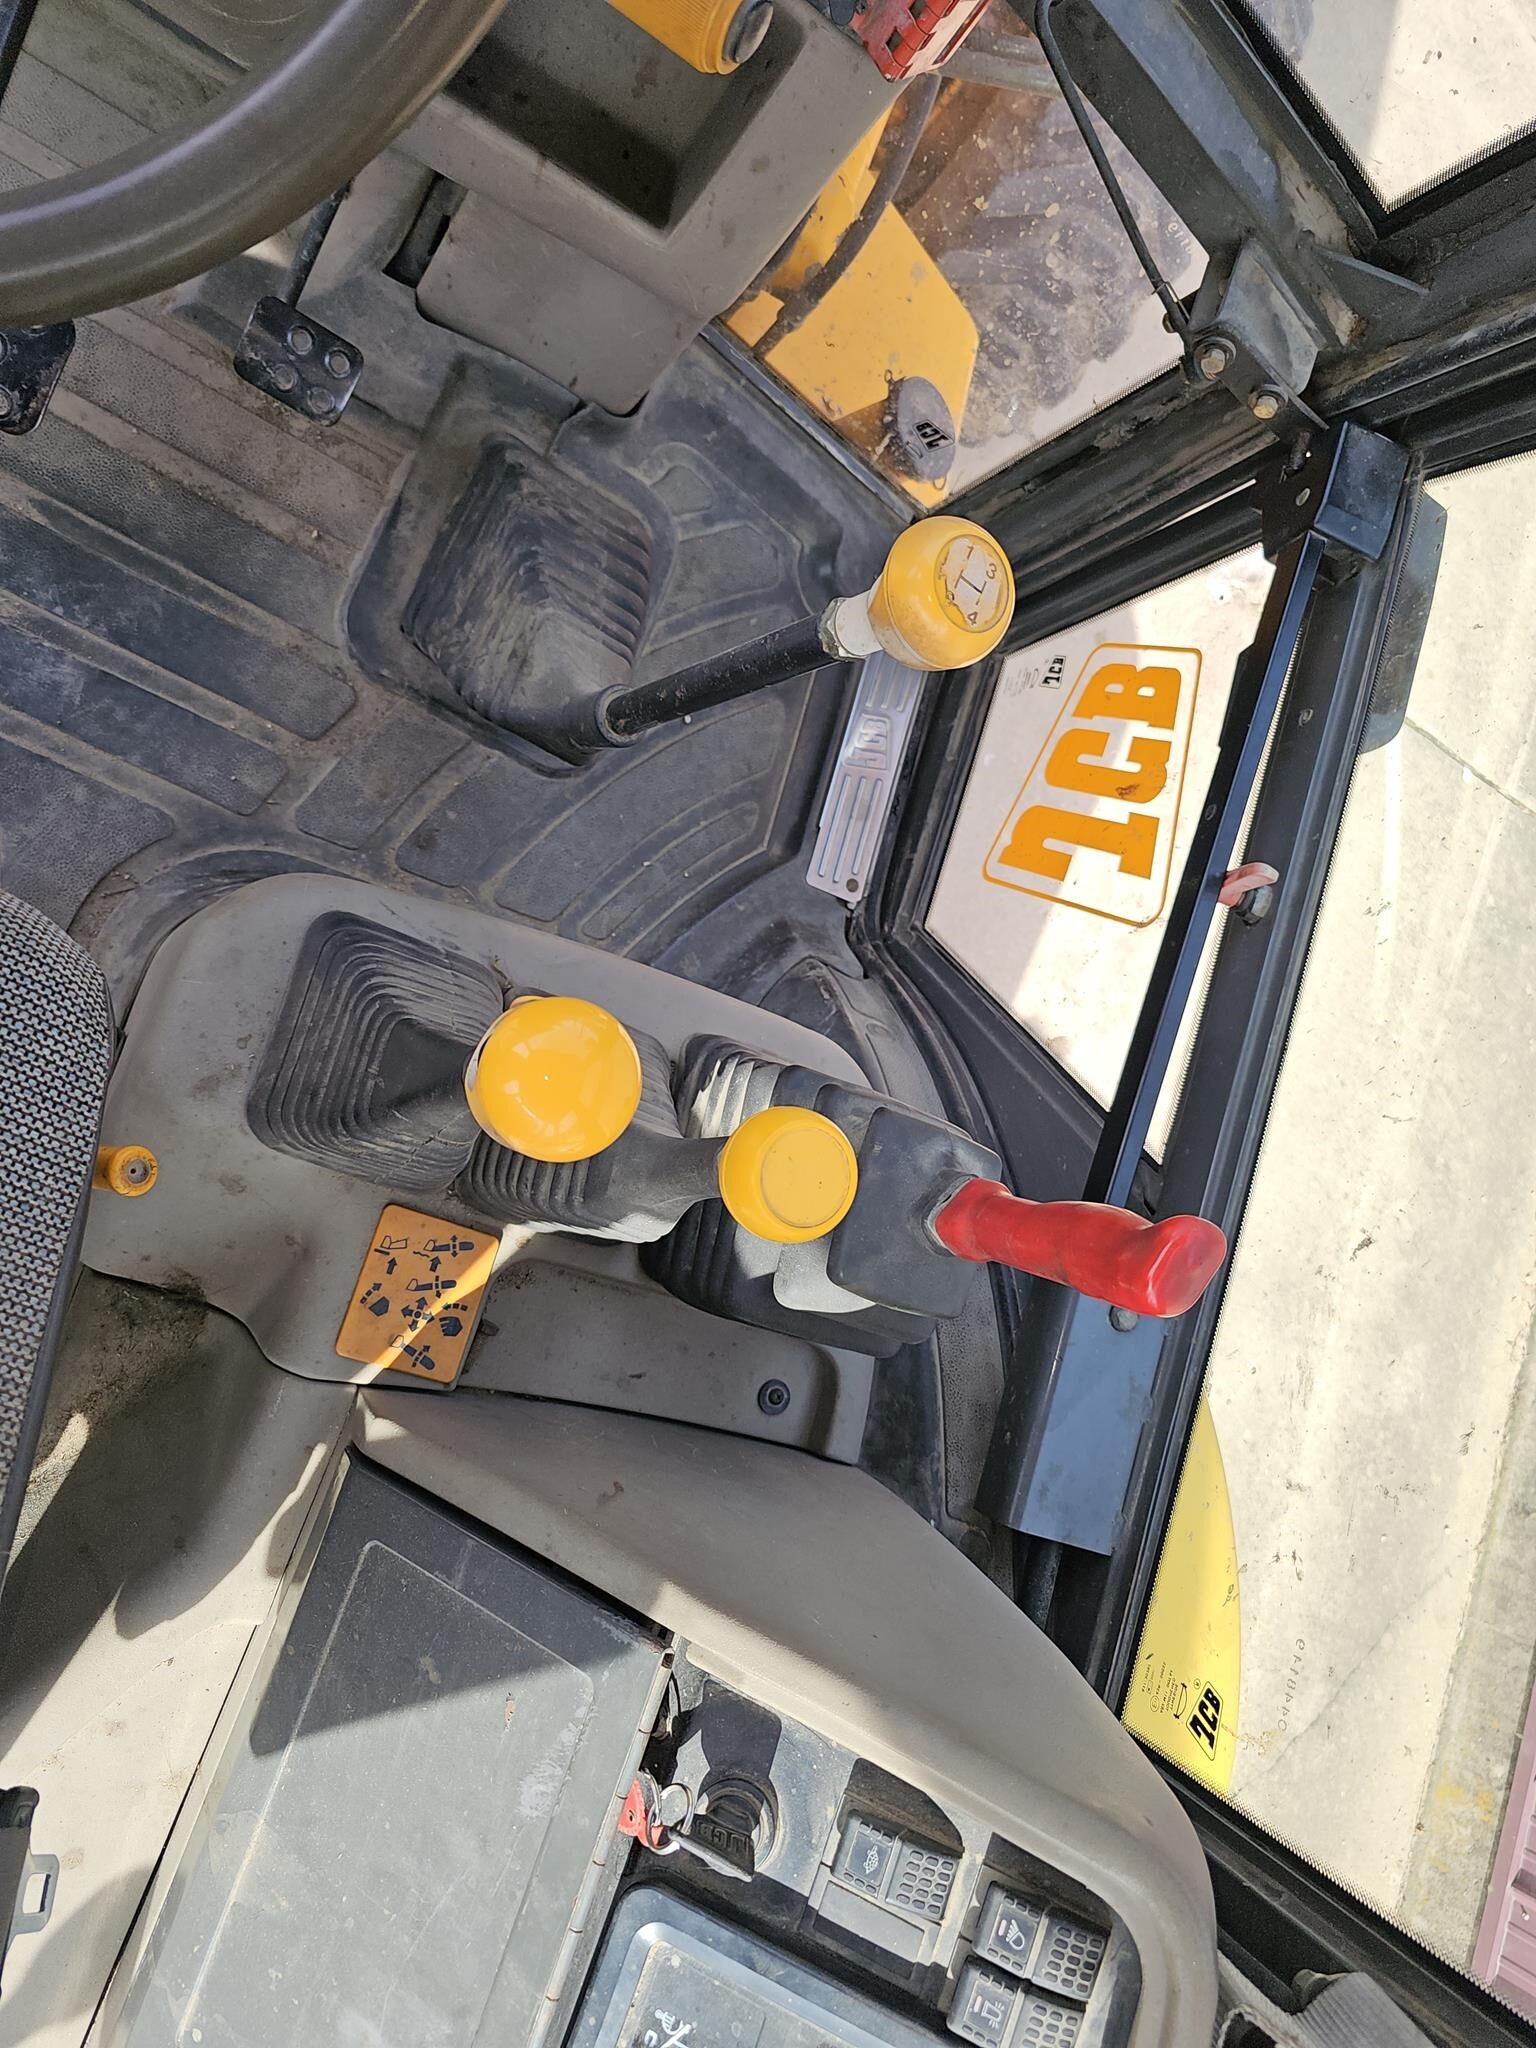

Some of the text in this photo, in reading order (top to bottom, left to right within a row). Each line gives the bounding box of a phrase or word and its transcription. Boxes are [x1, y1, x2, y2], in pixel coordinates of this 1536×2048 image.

[986, 563, 998, 580] 3
[967, 611, 978, 626] 4
[843, 717, 889, 771] JCB
[700, 1822, 747, 1857] JCB
